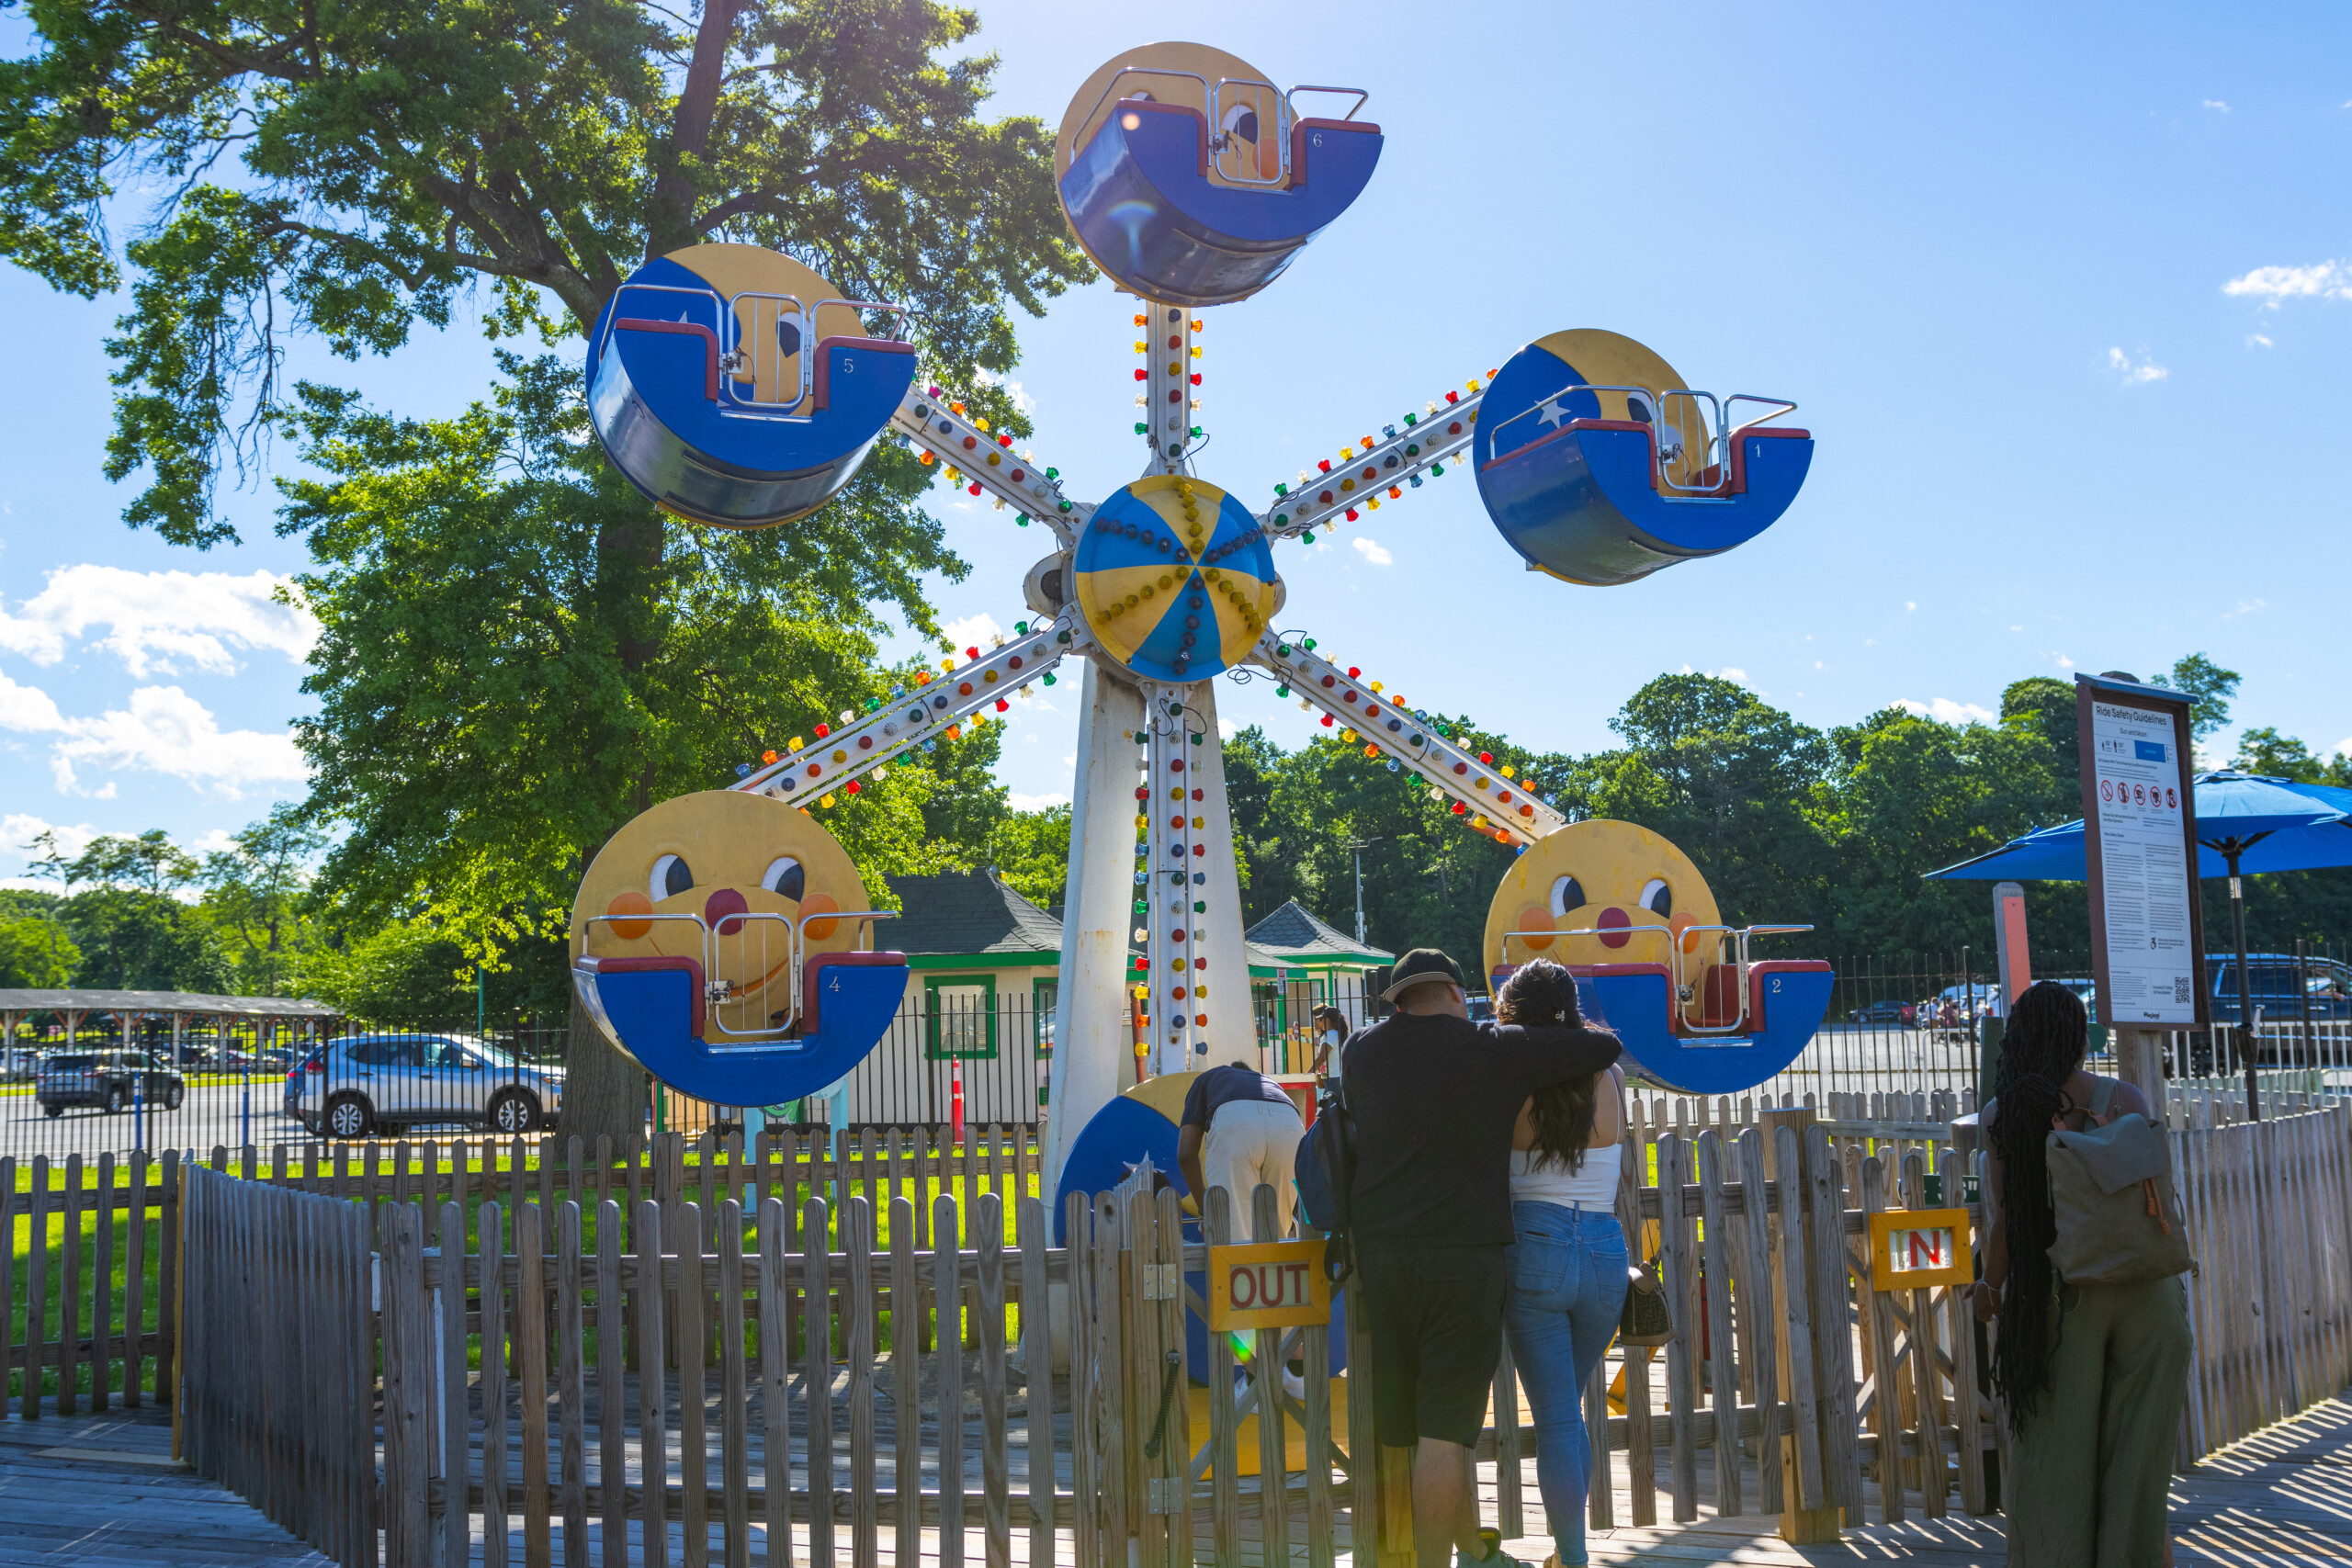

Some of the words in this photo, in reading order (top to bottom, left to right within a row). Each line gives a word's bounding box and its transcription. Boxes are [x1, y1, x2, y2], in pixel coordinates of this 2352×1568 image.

[1313, 133, 1323, 148] 6
[844, 358, 854, 374] 5
[1755, 444, 1761, 458] 1
[2096, 705, 2111, 716] Ride
[2111, 707, 2132, 722] Safety
[2132, 711, 2167, 726] Guidelines
[829, 976, 842, 992] 4
[1772, 978, 1781, 993] 2
[1230, 1263, 1309, 1309] OUT
